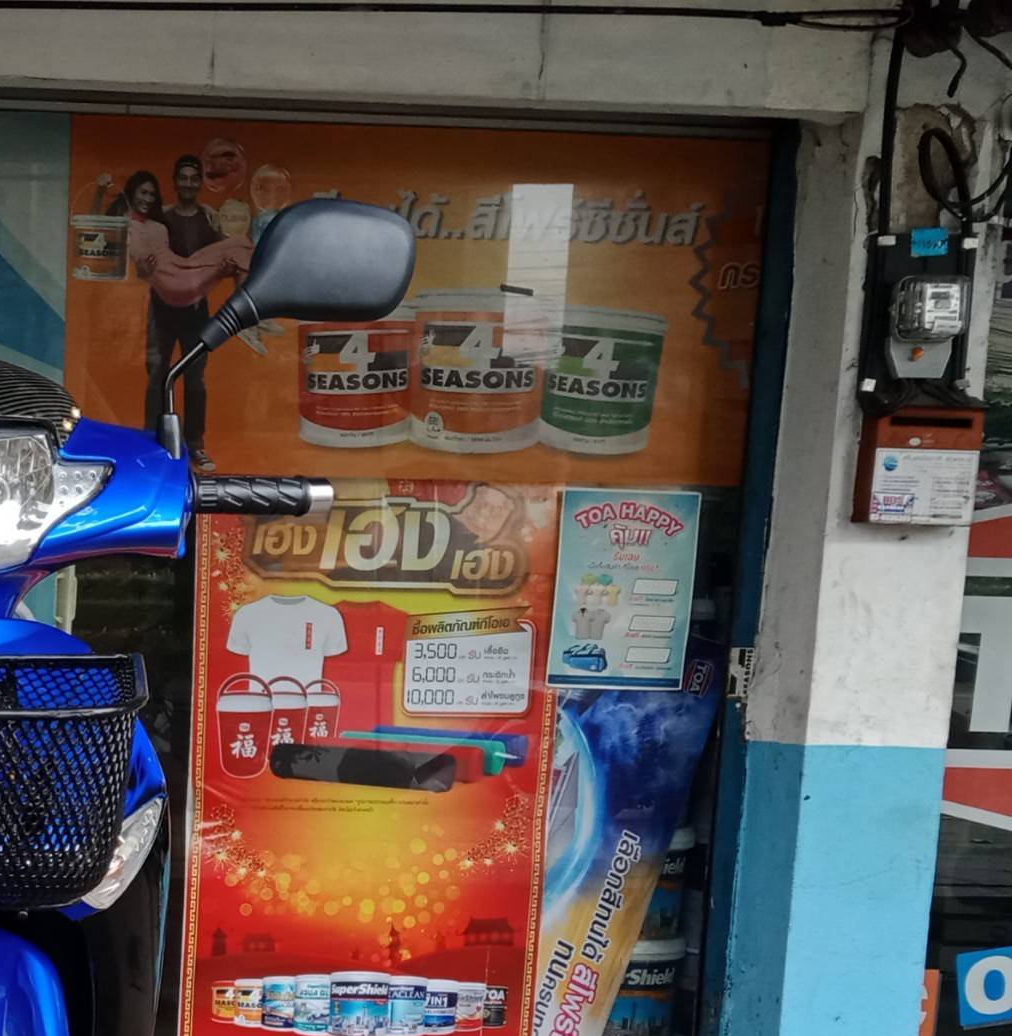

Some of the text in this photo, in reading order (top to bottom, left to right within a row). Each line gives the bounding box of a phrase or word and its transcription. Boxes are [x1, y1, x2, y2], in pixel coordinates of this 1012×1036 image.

[338, 332, 376, 372] 4
[459, 325, 501, 369] 4
[307, 369, 408, 390] SEASONS
[420, 368, 535, 390] SEASONS
[547, 377, 647, 400] SEASONS
[574, 502, 684, 537] TOA HAPPY
[414, 642, 458, 660] 3,500
[411, 666, 456, 683] 6,000
[407, 688, 455, 705] 10,000
[229, 734, 258, 759] 福
[624, 967, 676, 986] rShield
